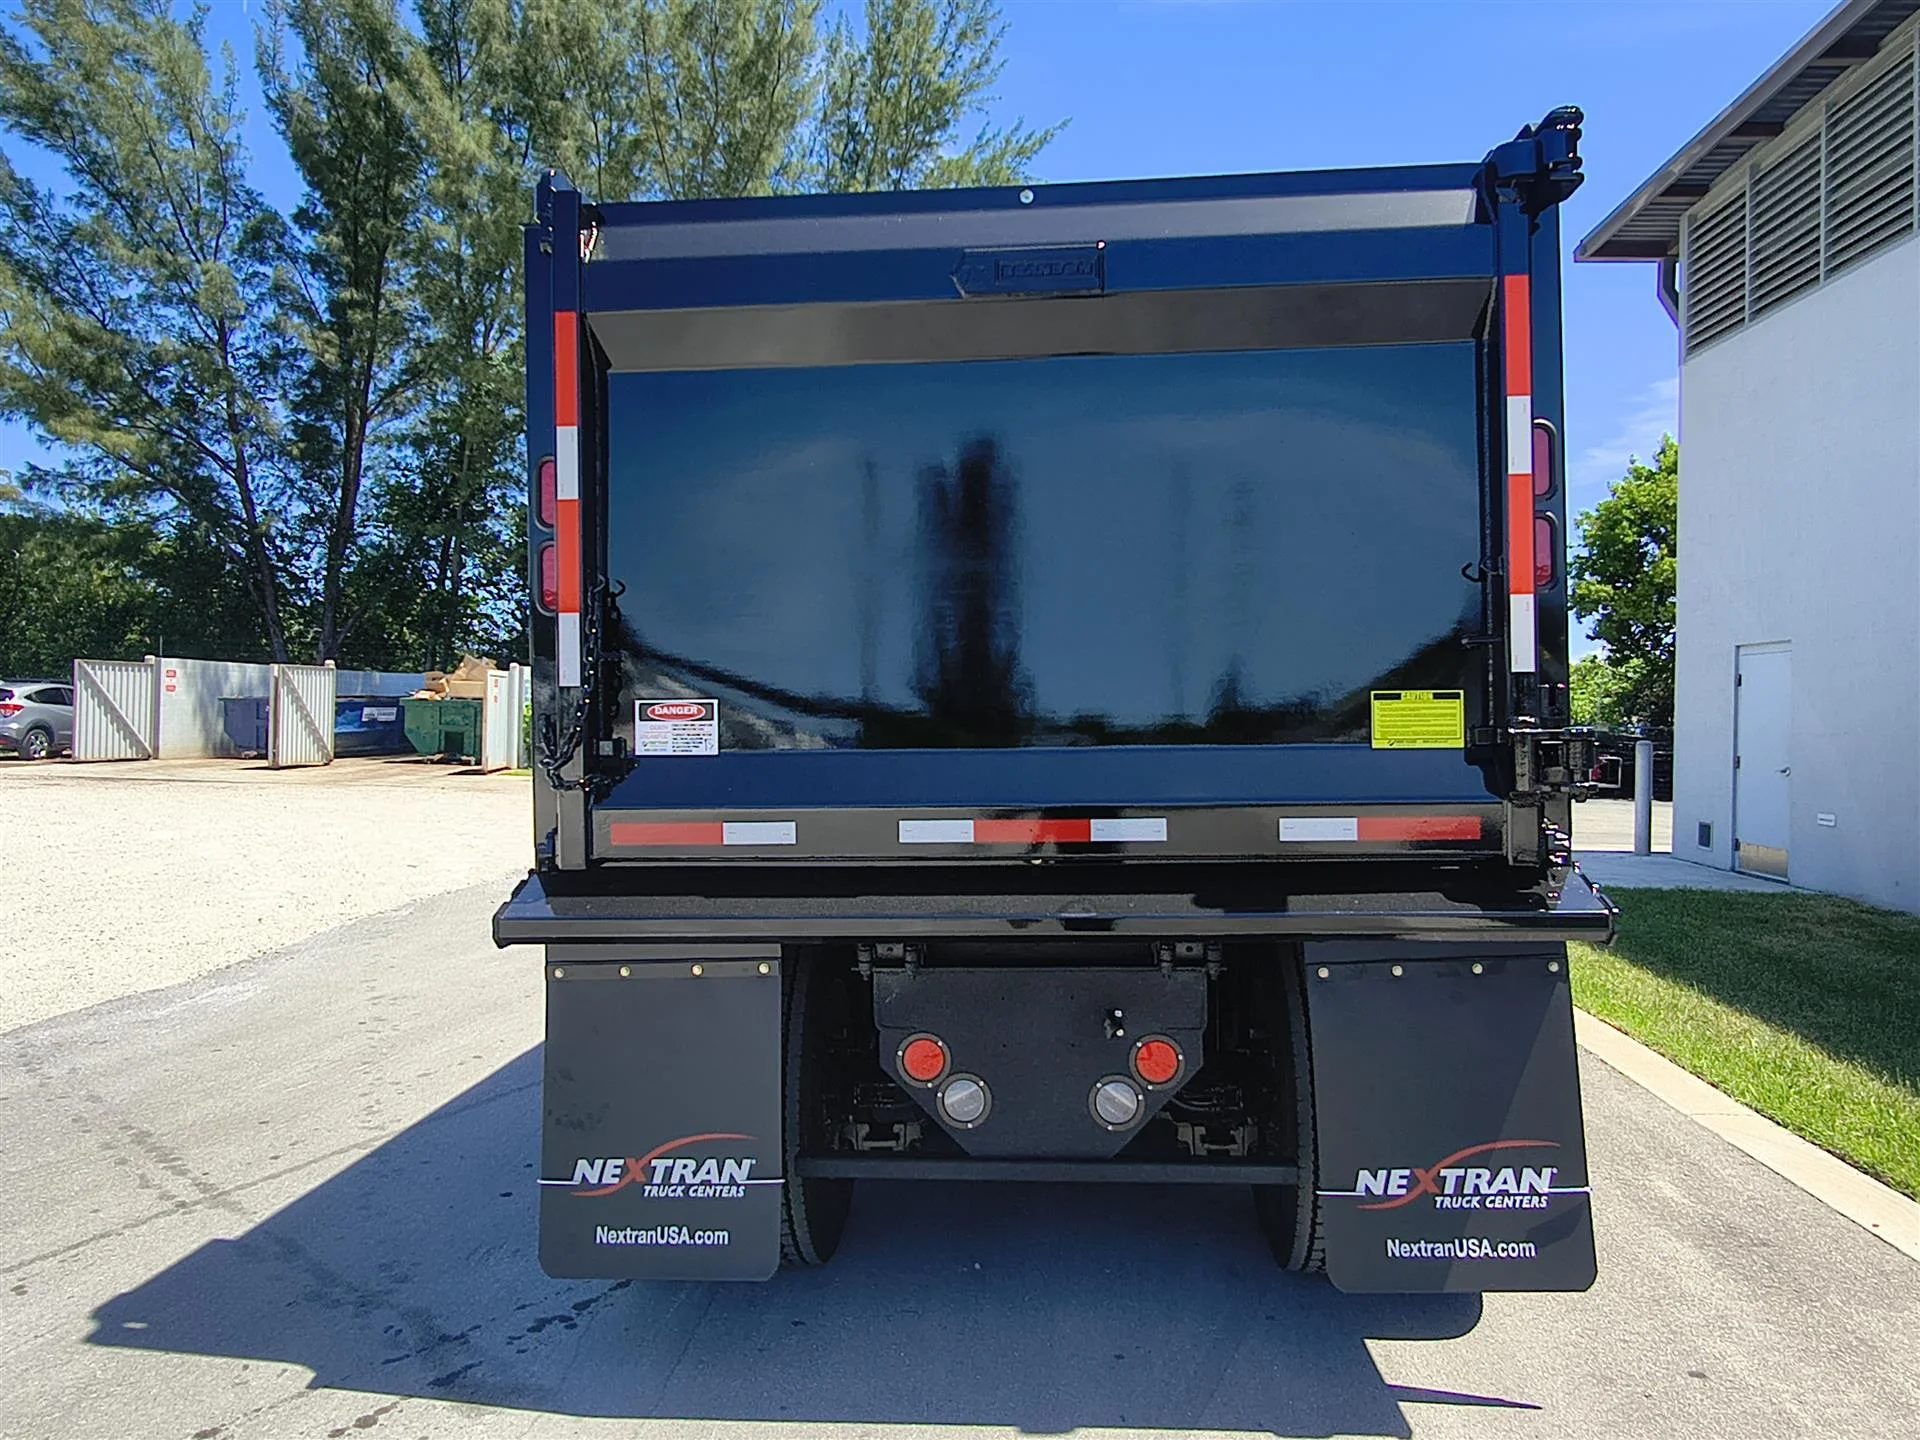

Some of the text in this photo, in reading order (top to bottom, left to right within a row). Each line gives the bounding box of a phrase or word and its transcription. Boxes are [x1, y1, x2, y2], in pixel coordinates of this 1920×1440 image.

[655, 706, 698, 715] DANGER
[572, 1158, 751, 1184] NEXTRAN
[1355, 1167, 1553, 1195] NEXTRAN
[643, 1185, 746, 1198] TRUCK CENTERS
[1434, 1195, 1549, 1209] TRUCK CENTERS
[595, 1225, 730, 1245] NextranUSA.com
[1386, 1238, 1537, 1259] NextranUSA.com
